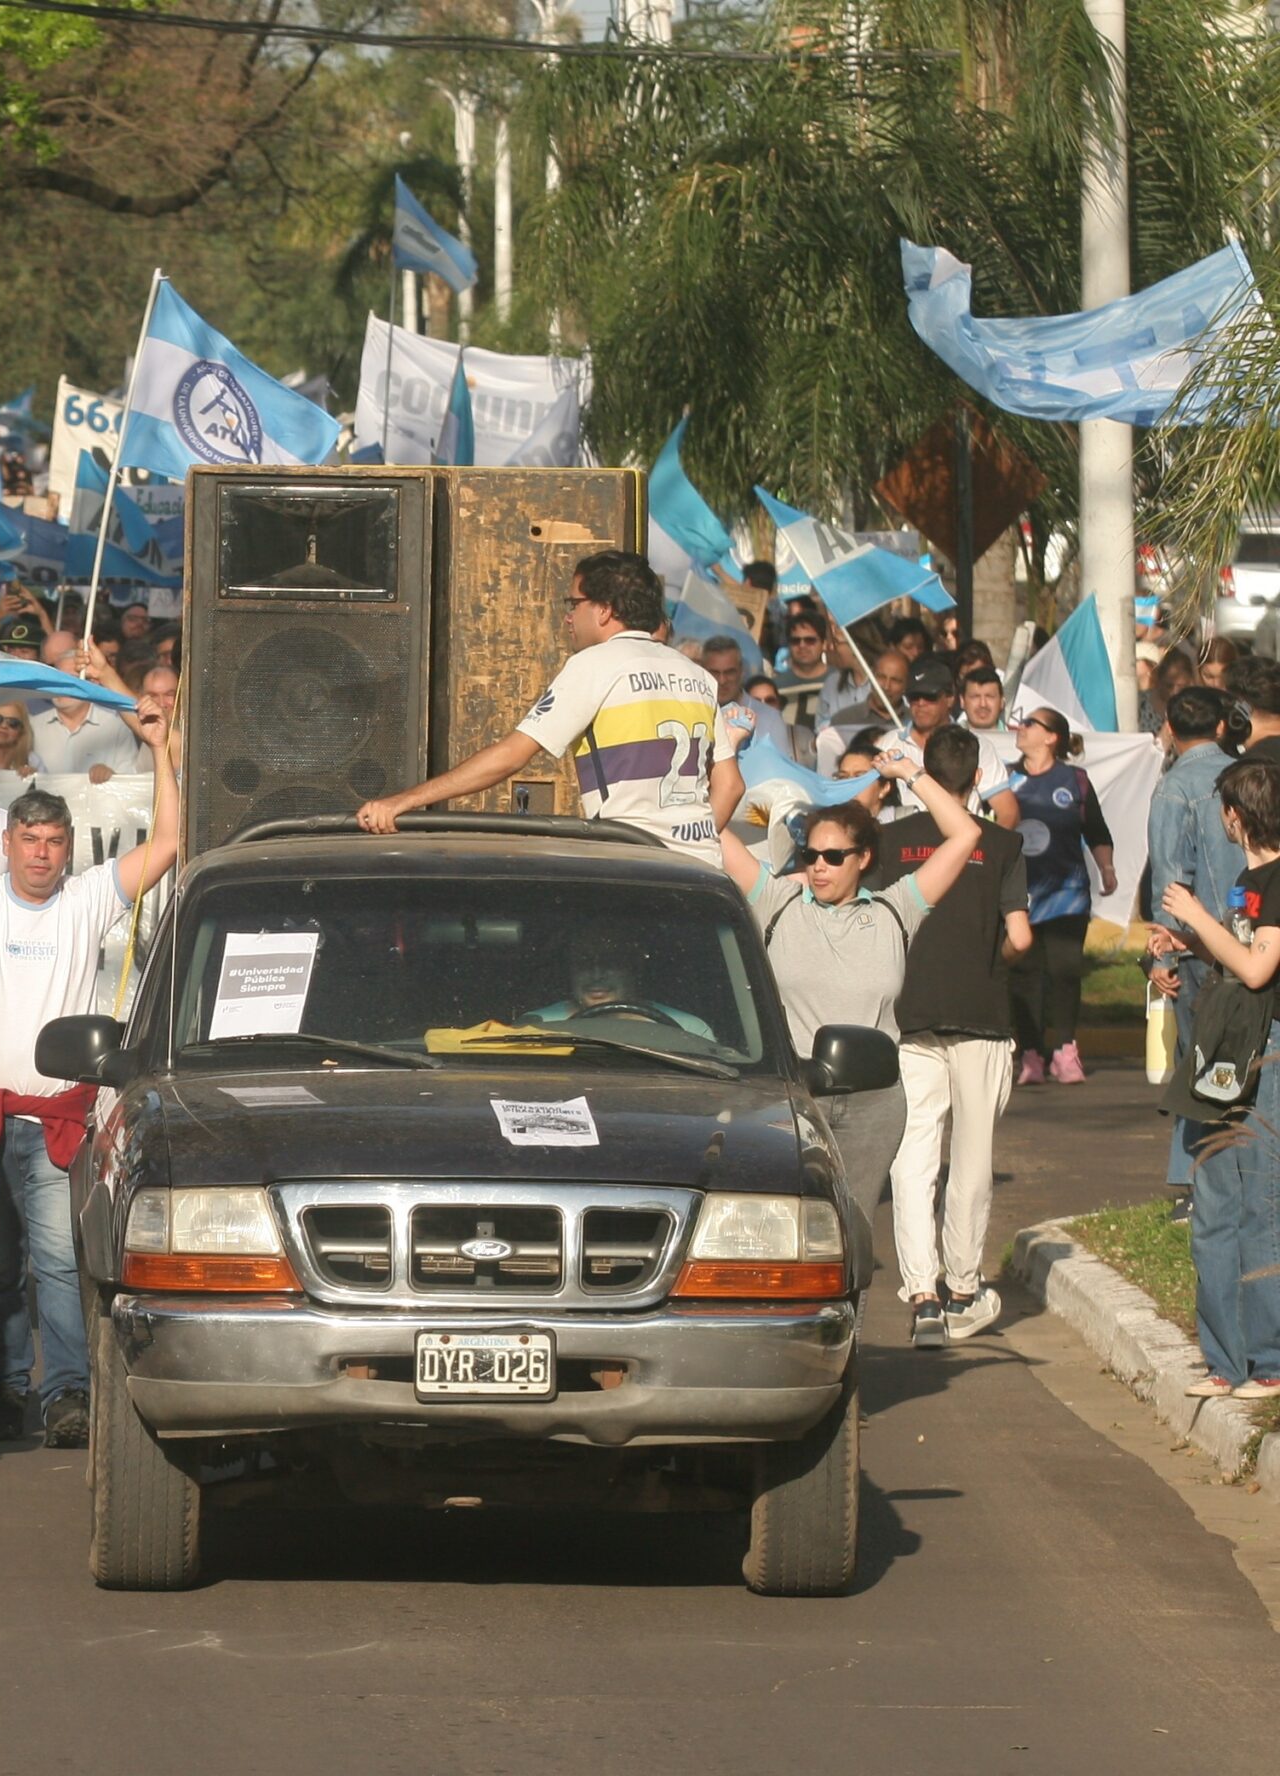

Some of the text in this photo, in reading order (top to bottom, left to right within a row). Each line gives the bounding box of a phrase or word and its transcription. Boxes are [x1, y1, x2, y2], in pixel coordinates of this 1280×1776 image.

[629, 672, 666, 692] BBVA
[657, 720, 708, 808] 21
[229, 966, 304, 977] #Universidad
[244, 975, 285, 984] Pública
[240, 983, 287, 993] Siempre
[457, 1338, 510, 1346] ARGENTINA
[424, 1350, 545, 1382] DYR 026
